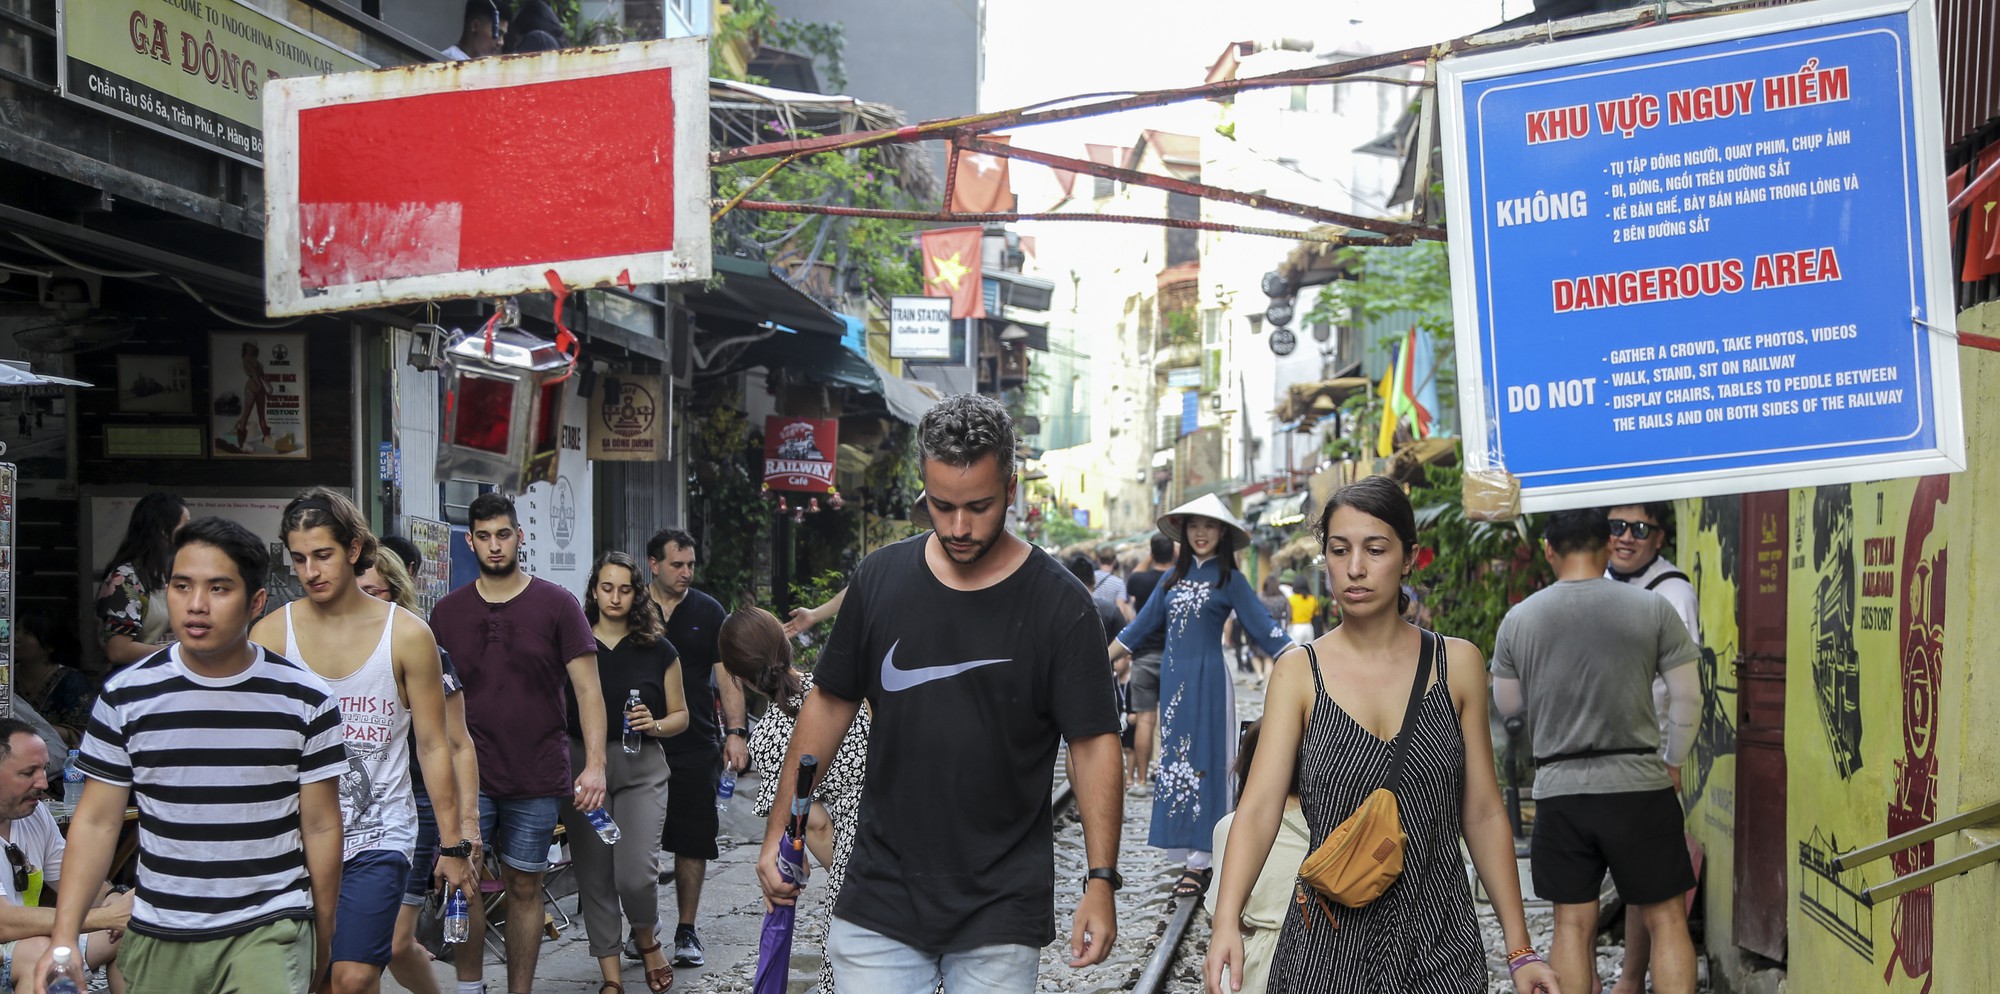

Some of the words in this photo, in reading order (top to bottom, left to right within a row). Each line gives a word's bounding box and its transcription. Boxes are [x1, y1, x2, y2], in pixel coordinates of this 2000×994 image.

[129, 9, 172, 66] GA
[205, 5, 219, 25] TO
[222, 13, 273, 51] INDOCHINA
[276, 38, 312, 68] STATION
[118, 85, 138, 107] Tàu
[140, 94, 154, 113] Số
[155, 100, 170, 121] 5a,
[171, 105, 193, 127] Trần
[194, 115, 215, 138] Phú,
[217, 123, 226, 140] P.
[227, 127, 250, 152] Hàng
[1525, 103, 1590, 145] KHU
[1594, 92, 1660, 139] VỰC
[1666, 78, 1756, 125] NGUY
[1762, 56, 1850, 111] HIỂM
[1609, 160, 1623, 177] TỤ
[1626, 156, 1647, 175] TẬP
[1650, 152, 1681, 170] ĐÔNG
[1683, 145, 1721, 165] NGƯỜI,
[1724, 143, 1752, 161] QUAY
[1755, 138, 1788, 156] PHIM,
[1791, 133, 1822, 151] CHỤP
[1826, 127, 1850, 146] ẢNH
[1611, 183, 1626, 198] ĐI,
[1628, 178, 1662, 195] ĐỨNG,
[1665, 170, 1692, 191] NGỒI
[1695, 168, 1724, 187] TRÊN
[1726, 163, 1765, 182] ĐƯỜNG
[1768, 157, 1790, 177] SẮT
[1612, 203, 1627, 220] KÊ
[1629, 201, 1653, 218] BÀN
[1655, 194, 1681, 214] GHẾ,
[1683, 193, 1705, 211] BÀY
[1708, 190, 1732, 208] BÁN
[1735, 187, 1766, 204] HÀNG
[1768, 182, 1807, 200] TRONG
[1809, 177, 1840, 195] LÒNG
[1843, 172, 1858, 190] VÀ
[1496, 189, 1587, 227] KHÔNG
[1613, 229, 1620, 242] 2
[1622, 224, 1645, 241] BÊN
[1647, 219, 1686, 238] ĐƯỜNG
[1689, 213, 1710, 233] SẮT
[1551, 257, 1744, 313] DANGEROUS
[1751, 246, 1842, 290] AREA
[892, 308, 915, 321] TRAIN
[917, 308, 950, 322] STATION
[1610, 346, 1655, 364] GATHER
[1658, 345, 1666, 359] A
[1669, 339, 1719, 357] CROWD,
[1721, 335, 1751, 352] TAKE
[1755, 330, 1808, 348] PHOTOS,
[1811, 323, 1857, 342] VIDEOS
[1611, 369, 1649, 386] WALK,
[1653, 365, 1695, 382] STAND,
[1698, 362, 1718, 377] SIT
[1721, 359, 1739, 375] ON
[1742, 353, 1795, 372] RAILWAY
[1612, 391, 1661, 409] DISPLAY
[1665, 385, 1714, 403] CHAIRS,
[1717, 380, 1762, 398] TABLES
[1765, 378, 1781, 393] TO
[1784, 373, 1832, 391] PEDDLE
[1835, 366, 1897, 386] BETWEEN
[1507, 383, 1540, 412] DO
[1547, 377, 1596, 408] NOT
[1612, 416, 1635, 431] THE
[1638, 412, 1673, 429] RAILS
[1676, 409, 1702, 425] AND
[1705, 407, 1723, 422] ON
[1726, 404, 1758, 420] BOTH
[1761, 399, 1798, 416] SIDES
[1802, 397, 1817, 412] OF
[1820, 395, 1844, 410] THE
[1847, 388, 1903, 408] RAILWAY
[562, 424, 581, 451] ETABLE
[765, 459, 833, 478] RAILWAY
[788, 476, 809, 486] Café
[1861, 606, 1894, 631] HISTORY
[340, 696, 376, 714] THIS
[383, 699, 395, 717] IS
